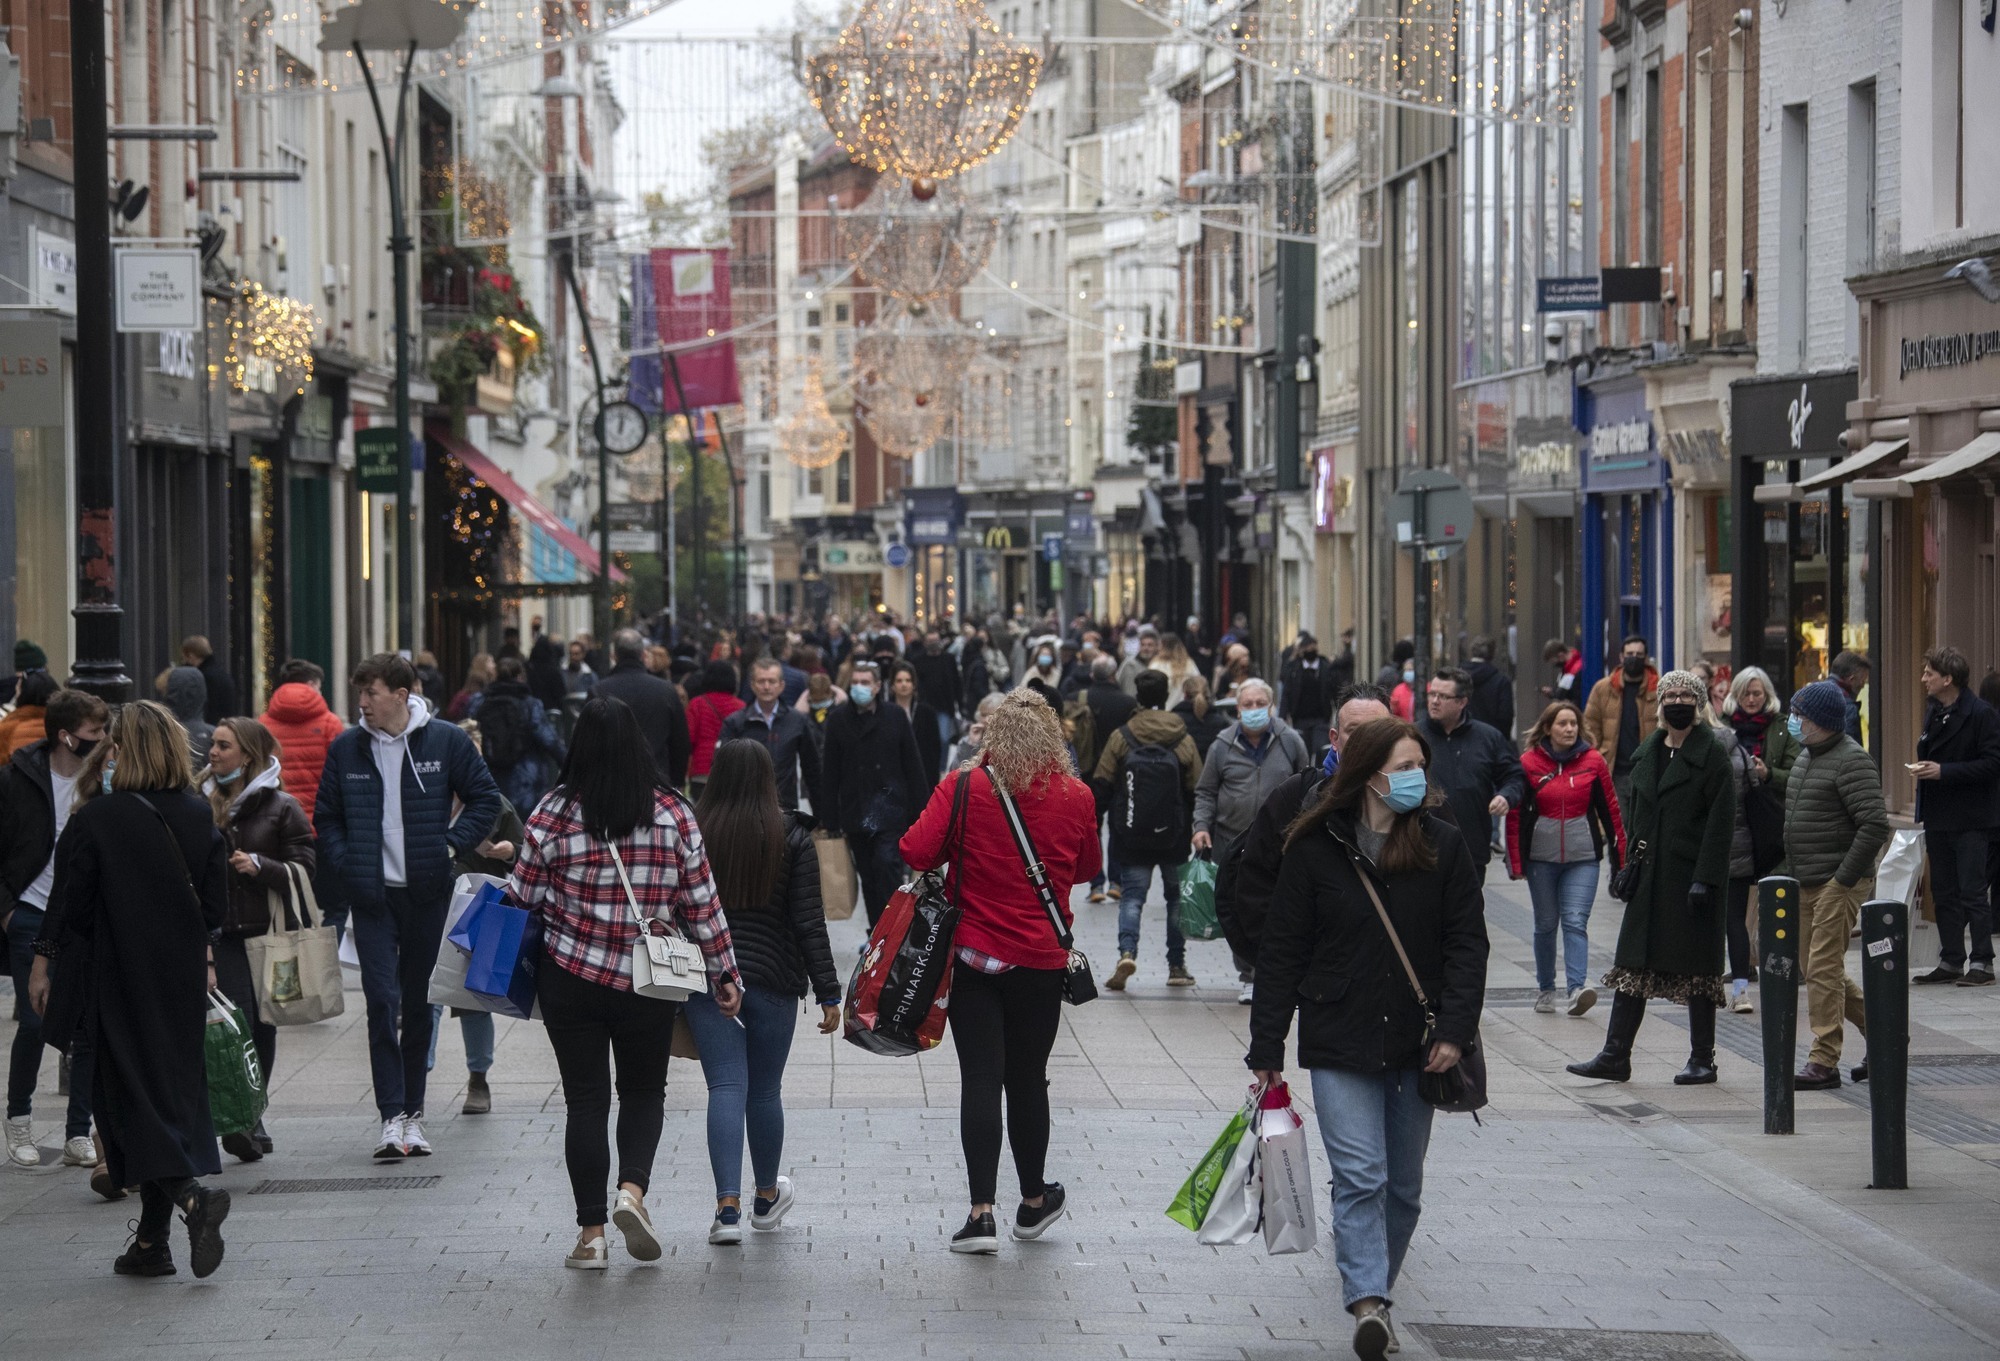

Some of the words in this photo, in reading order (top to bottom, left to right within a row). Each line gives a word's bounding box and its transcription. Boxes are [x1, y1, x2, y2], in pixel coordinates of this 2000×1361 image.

[149, 271, 169, 280] THE
[139, 282, 174, 290] WHITE
[130, 292, 185, 302] COMPANY
[1900, 338, 1922, 379] JOHN
[1924, 333, 1974, 368] BRERETON
[1975, 330, 2000, 360] JEWELL
[893, 924, 940, 1023] PRIMARK.com
[1292, 1194, 1302, 1214] ONLINE
[1298, 1214, 1306, 1229] SHOP
